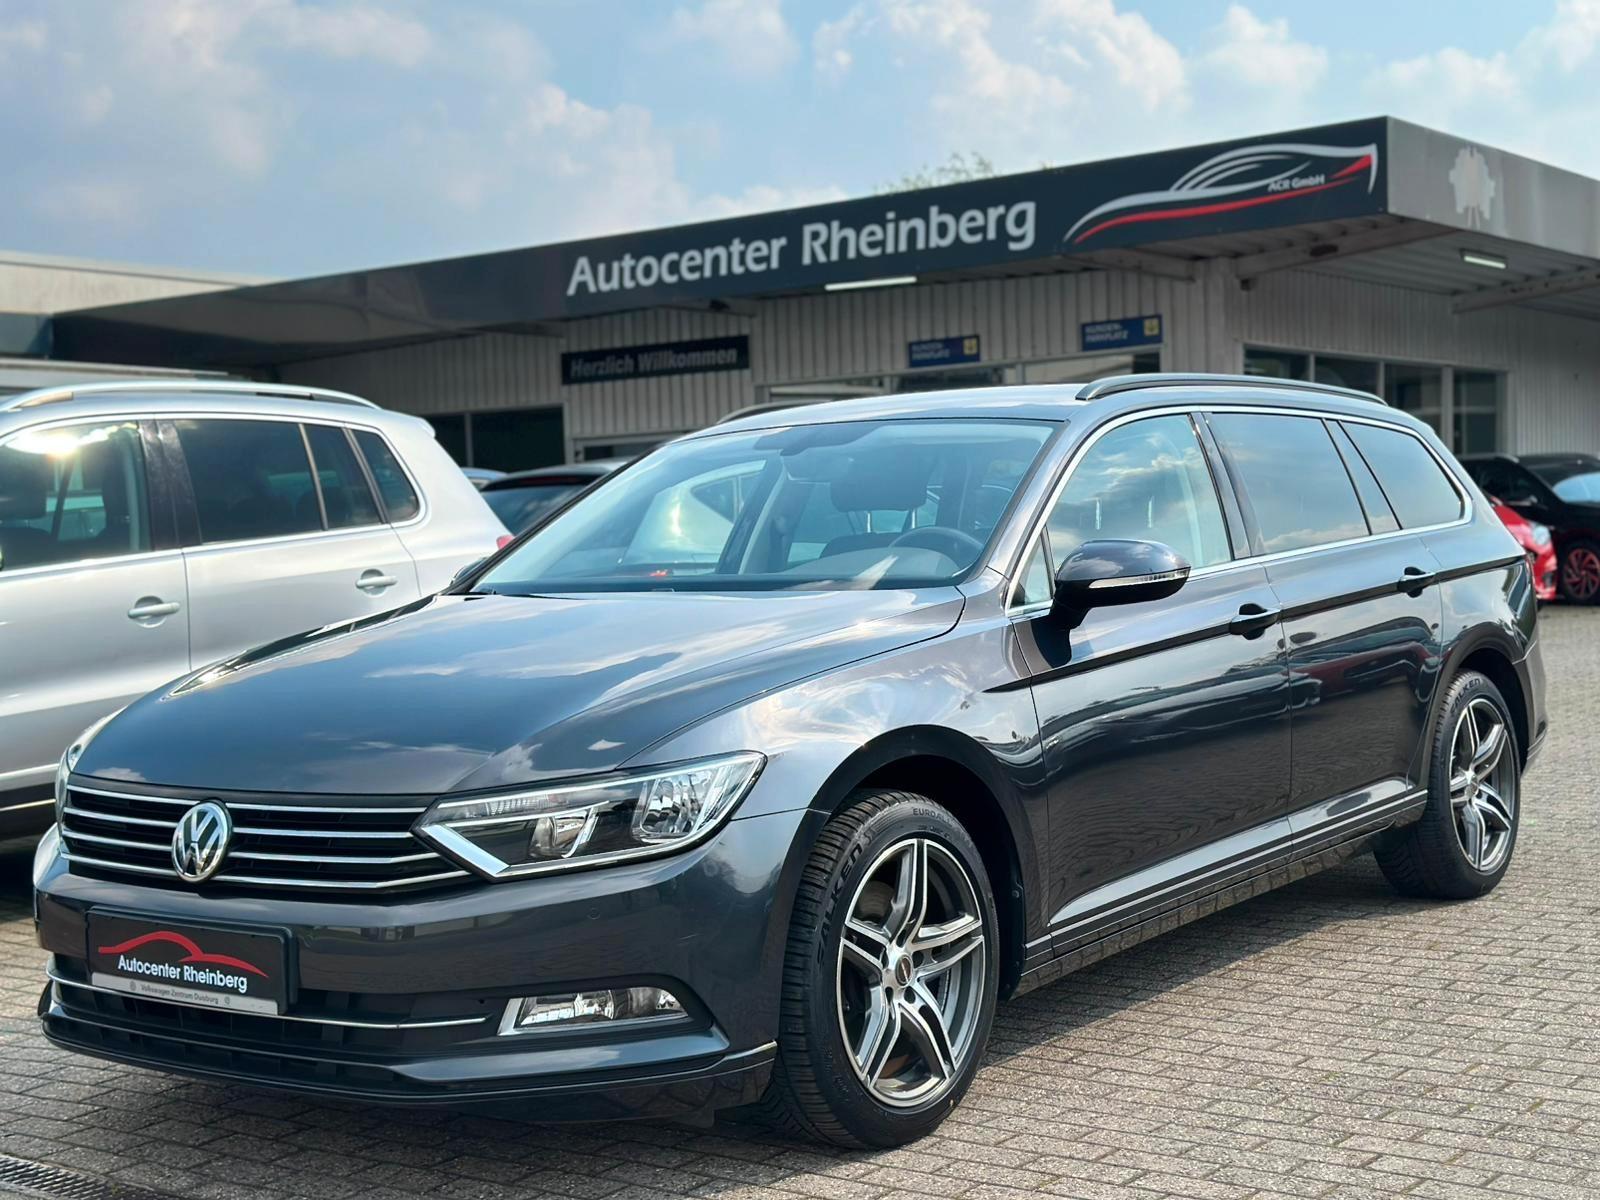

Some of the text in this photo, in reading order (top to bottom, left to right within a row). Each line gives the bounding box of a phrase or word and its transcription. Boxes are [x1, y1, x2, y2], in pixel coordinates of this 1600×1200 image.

[1267, 174, 1325, 192] ACR GmbH
[567, 201, 1036, 296] Autocenter Rheinberg
[570, 348, 737, 377] Herzlich Willkommen
[117, 955, 248, 993] Autocenter Rheinberg
